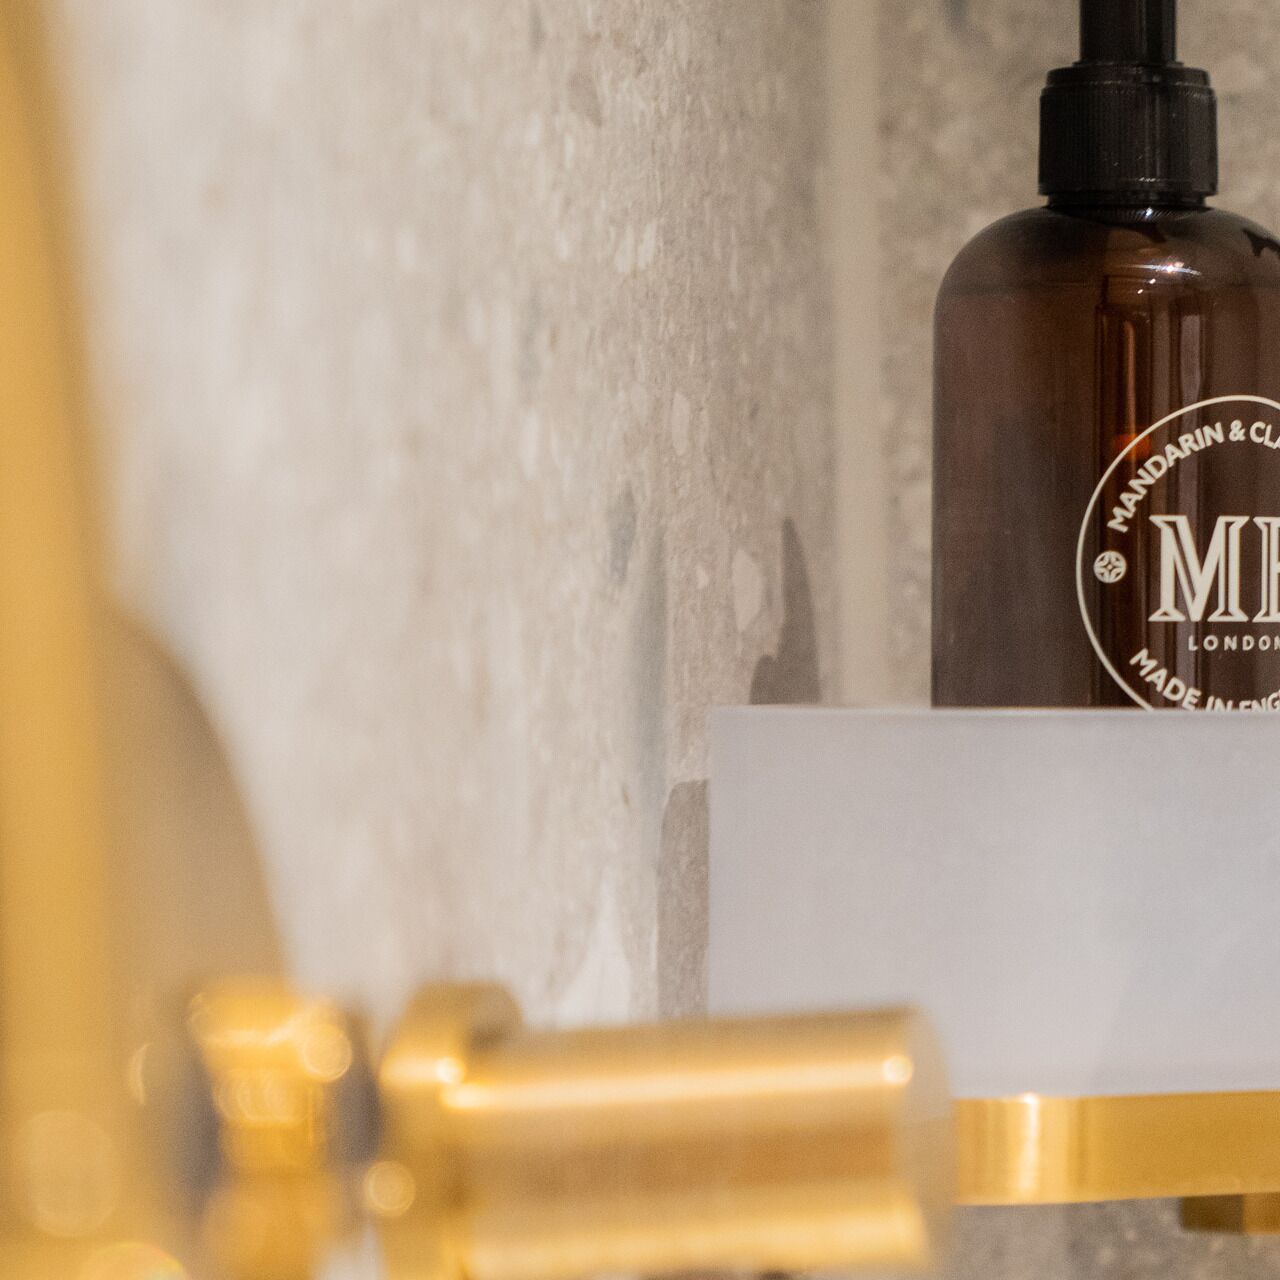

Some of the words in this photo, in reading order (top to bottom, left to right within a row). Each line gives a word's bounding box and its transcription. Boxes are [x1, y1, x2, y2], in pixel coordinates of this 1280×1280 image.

[1106, 422, 1225, 533] MANDARIN
[1228, 419, 1246, 441] &
[1129, 648, 1201, 711] MADE
